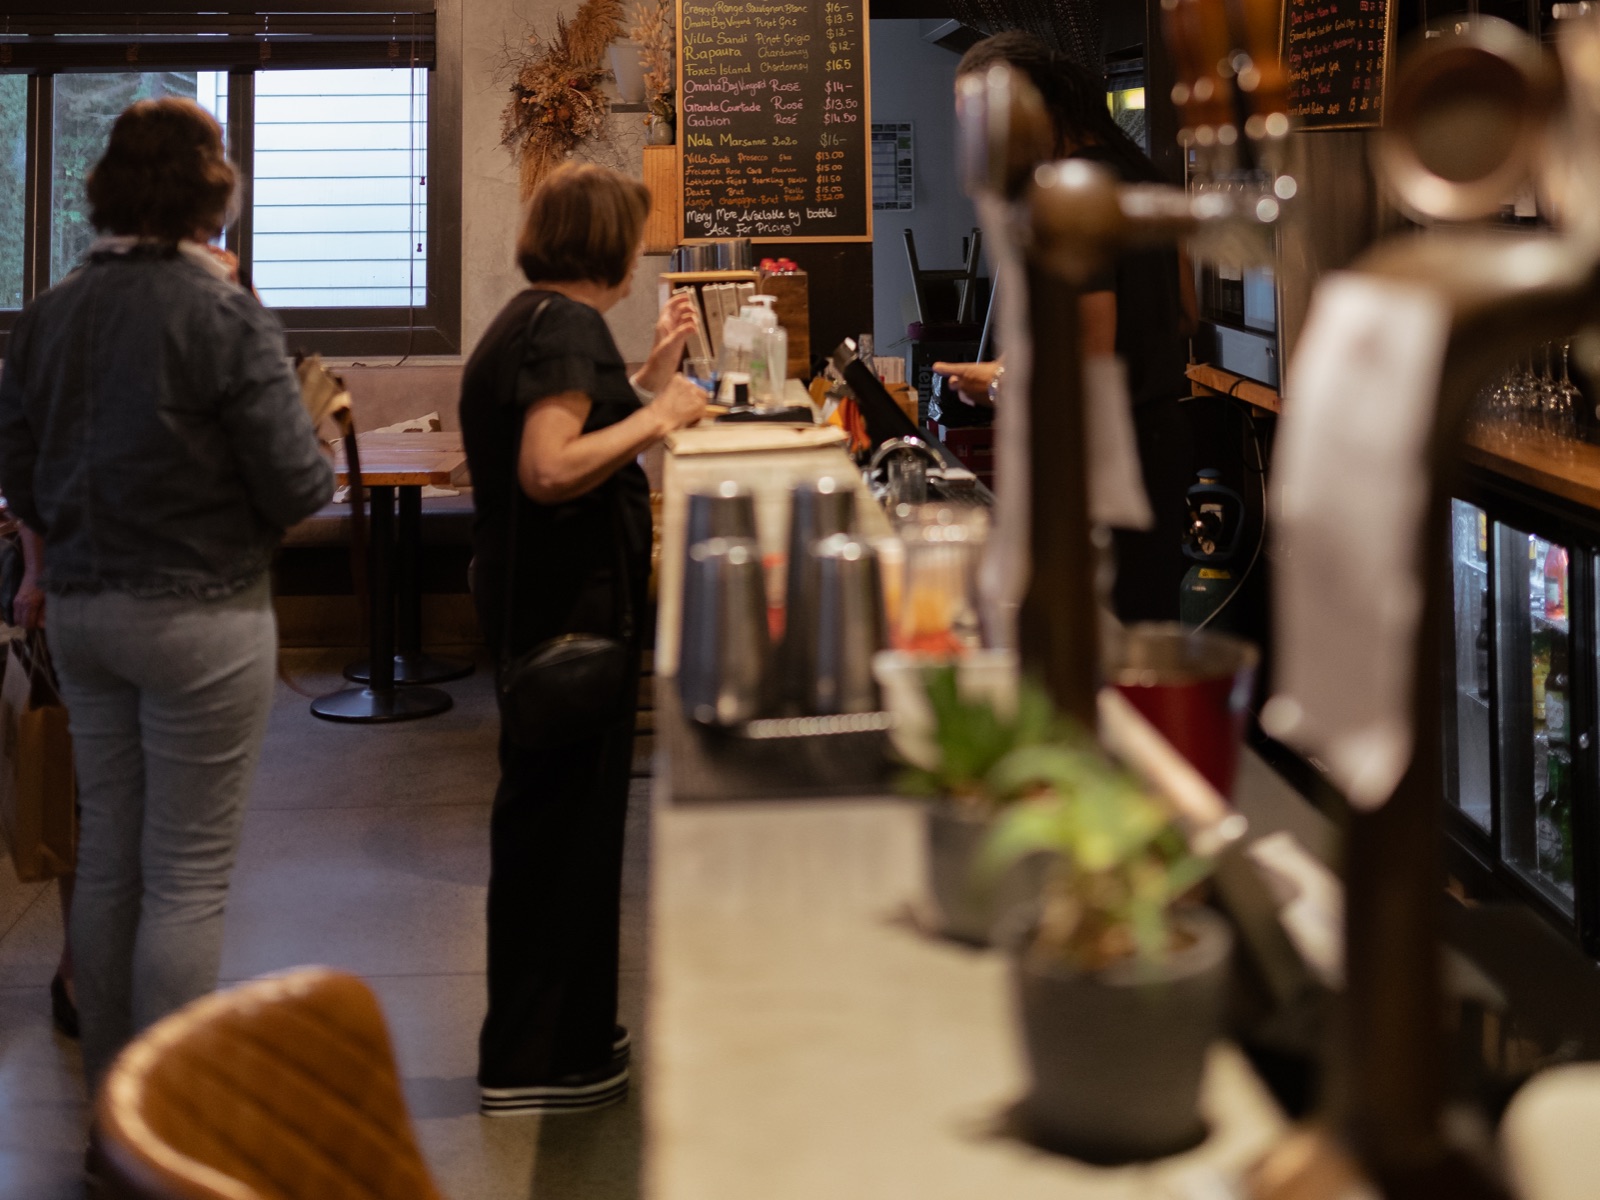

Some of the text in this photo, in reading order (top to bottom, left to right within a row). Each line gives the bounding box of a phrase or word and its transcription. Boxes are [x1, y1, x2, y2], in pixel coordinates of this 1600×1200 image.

[683, 2, 716, 16] Craggy
[715, 0, 743, 16] Range
[683, 16, 710, 30] Omaha
[712, 16, 726, 29] Bay
[754, 16, 776, 29] Pinot
[779, 16, 797, 29] Gris
[684, 33, 713, 45] Villa
[717, 32, 748, 45] Sandi
[755, 32, 780, 46] Pinot
[784, 33, 811, 46] Grigio
[683, 45, 742, 64] Rapaura
[684, 63, 717, 76] Foxes
[720, 62, 751, 75] Island
[684, 79, 721, 93] Omaha
[718, 76, 739, 96] Bay
[684, 95, 858, 113] Grande Courtade Rosé $13.50
[687, 112, 857, 127] Gabion Rosé $14.50
[687, 133, 713, 147] Nola
[720, 133, 767, 147] Marsanne
[772, 136, 798, 146] 2020
[684, 153, 708, 164] Villa
[709, 153, 730, 165] Sandi
[737, 152, 768, 163] Prosecco
[685, 187, 711, 196] Deutz
[726, 187, 745, 196] Brut
[686, 210, 712, 228] Many
[716, 208, 738, 221] More
[738, 209, 786, 222] Available
[788, 209, 801, 227] by
[705, 222, 793, 238] Ask For Pricing
